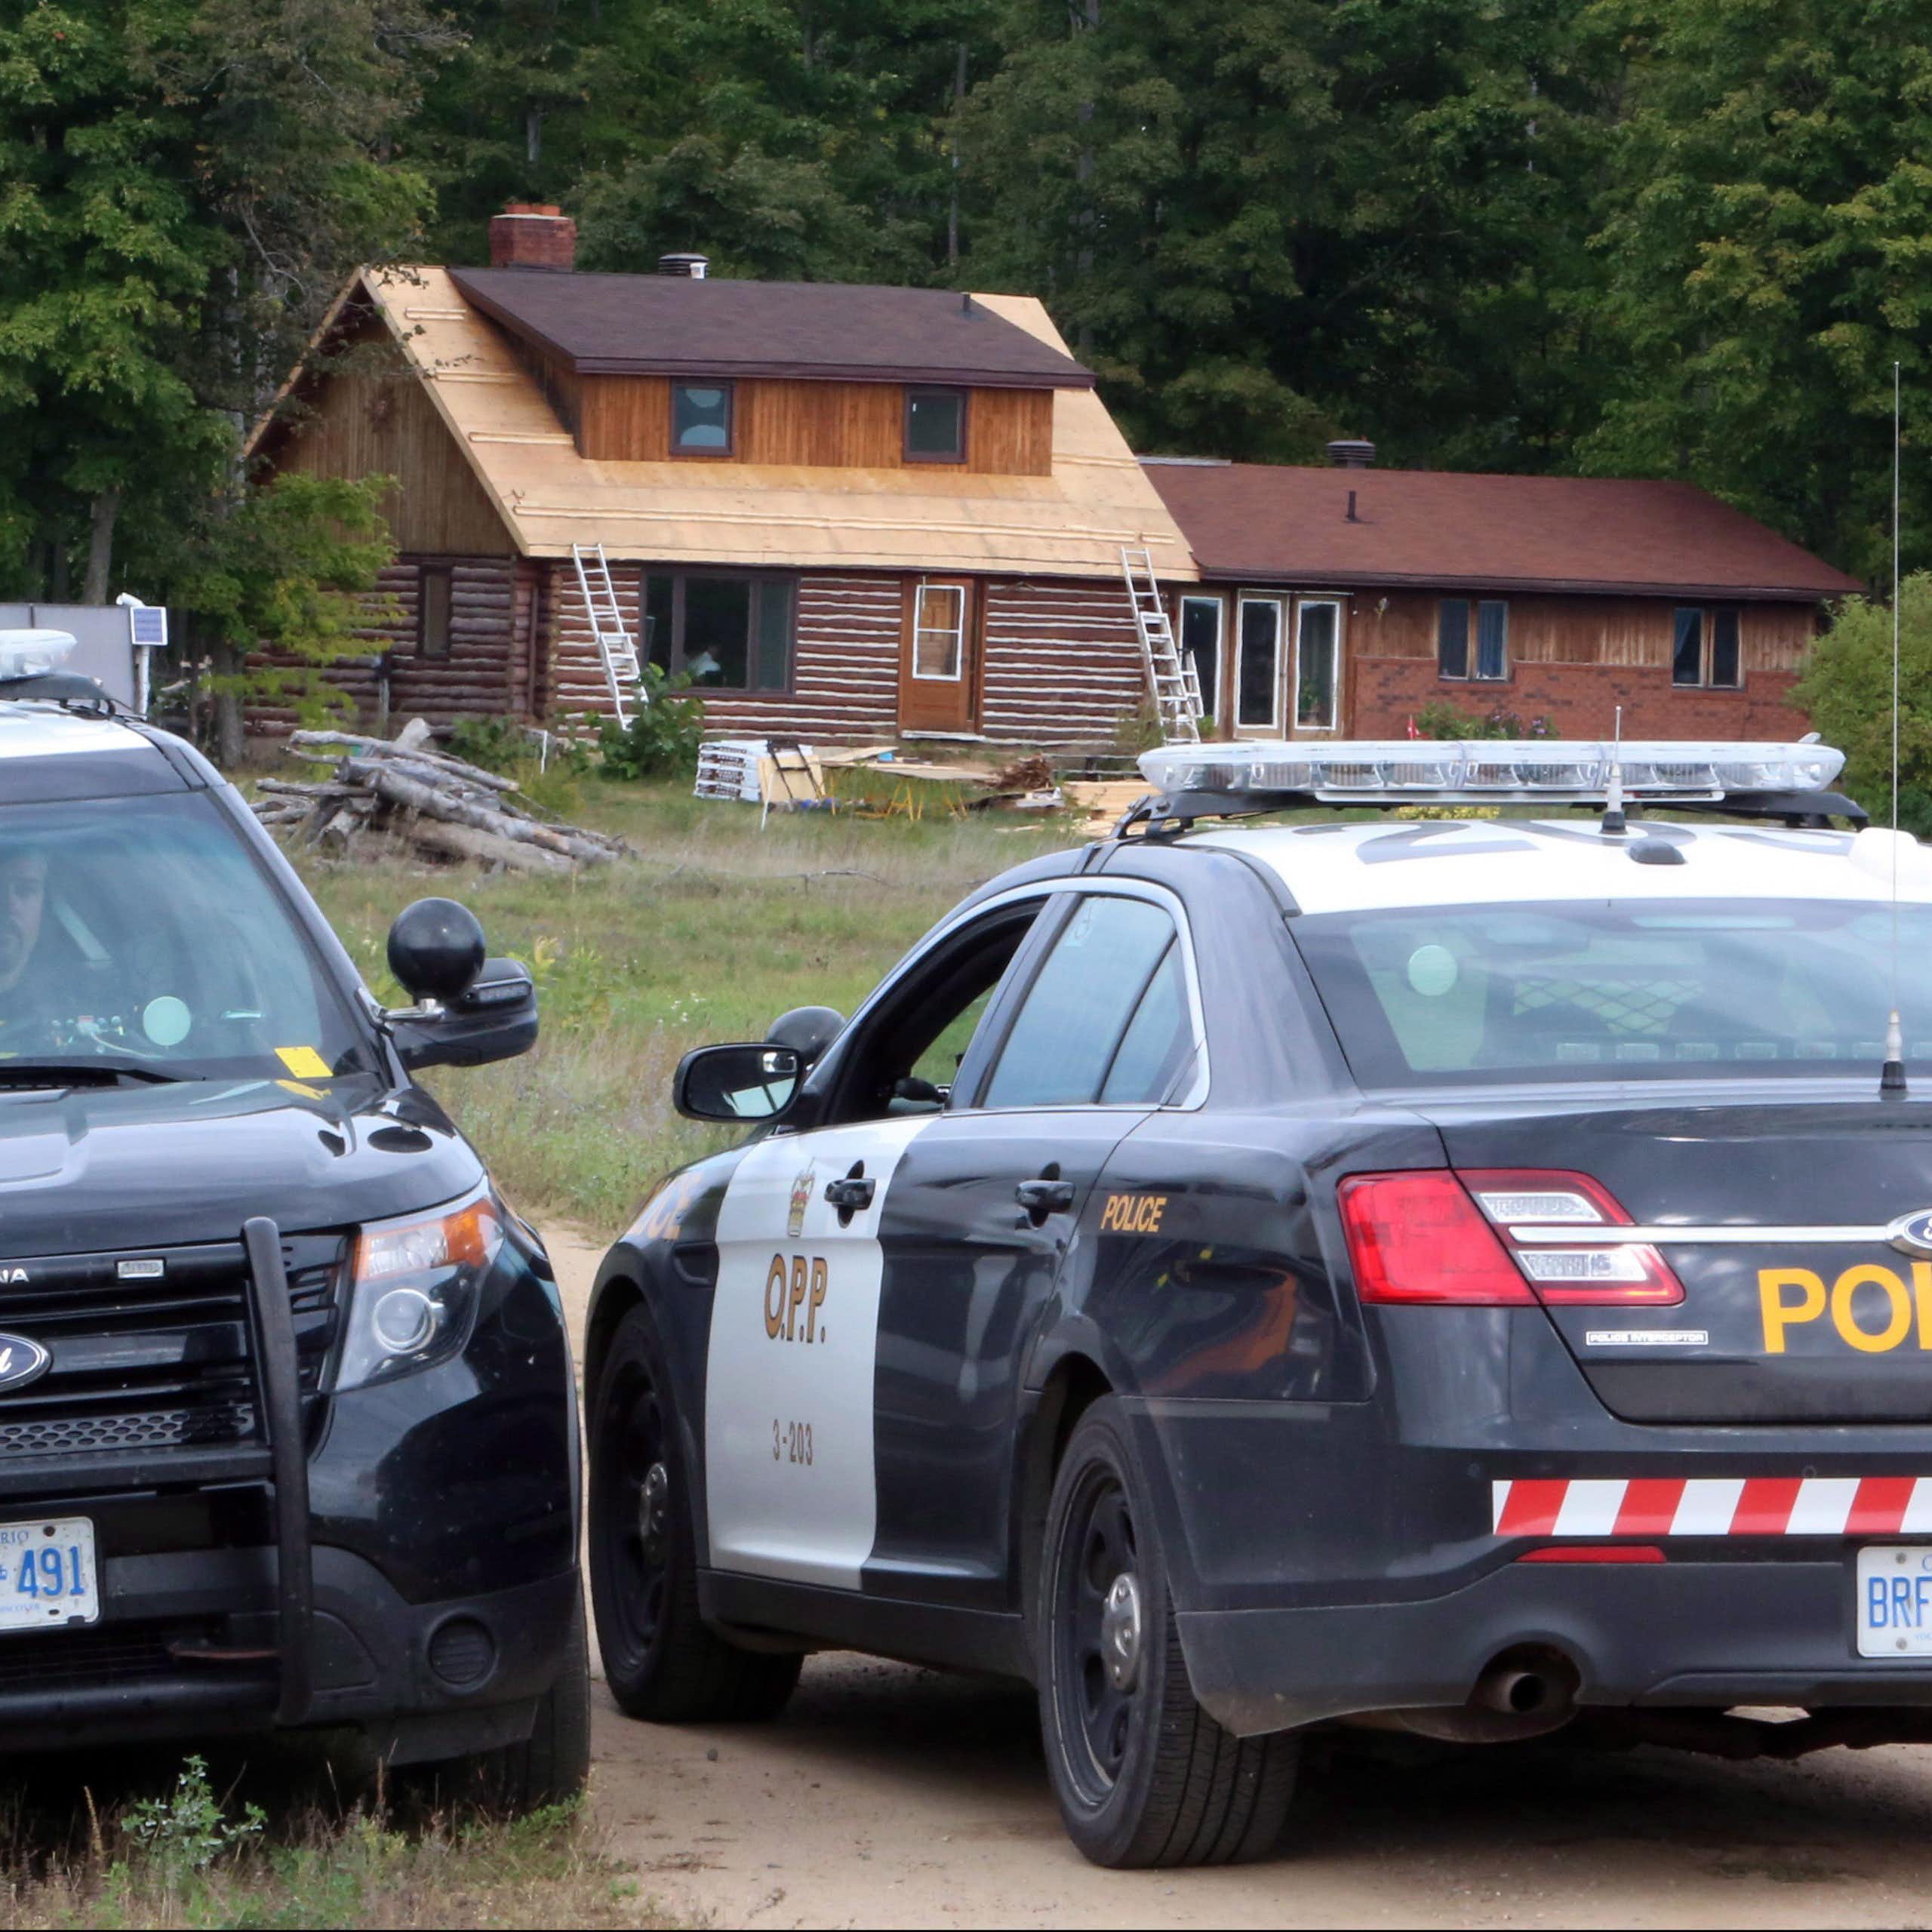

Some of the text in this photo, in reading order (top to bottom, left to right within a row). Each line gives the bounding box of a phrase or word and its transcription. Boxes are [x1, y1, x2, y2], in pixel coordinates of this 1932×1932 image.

[1100, 1195, 1167, 1232] POLICE
[764, 1253, 827, 1343] O.P.P.
[773, 1419, 813, 1466] 3-203
[17, 1546, 85, 1598] 491
[1869, 1576, 1932, 1628] BRF
